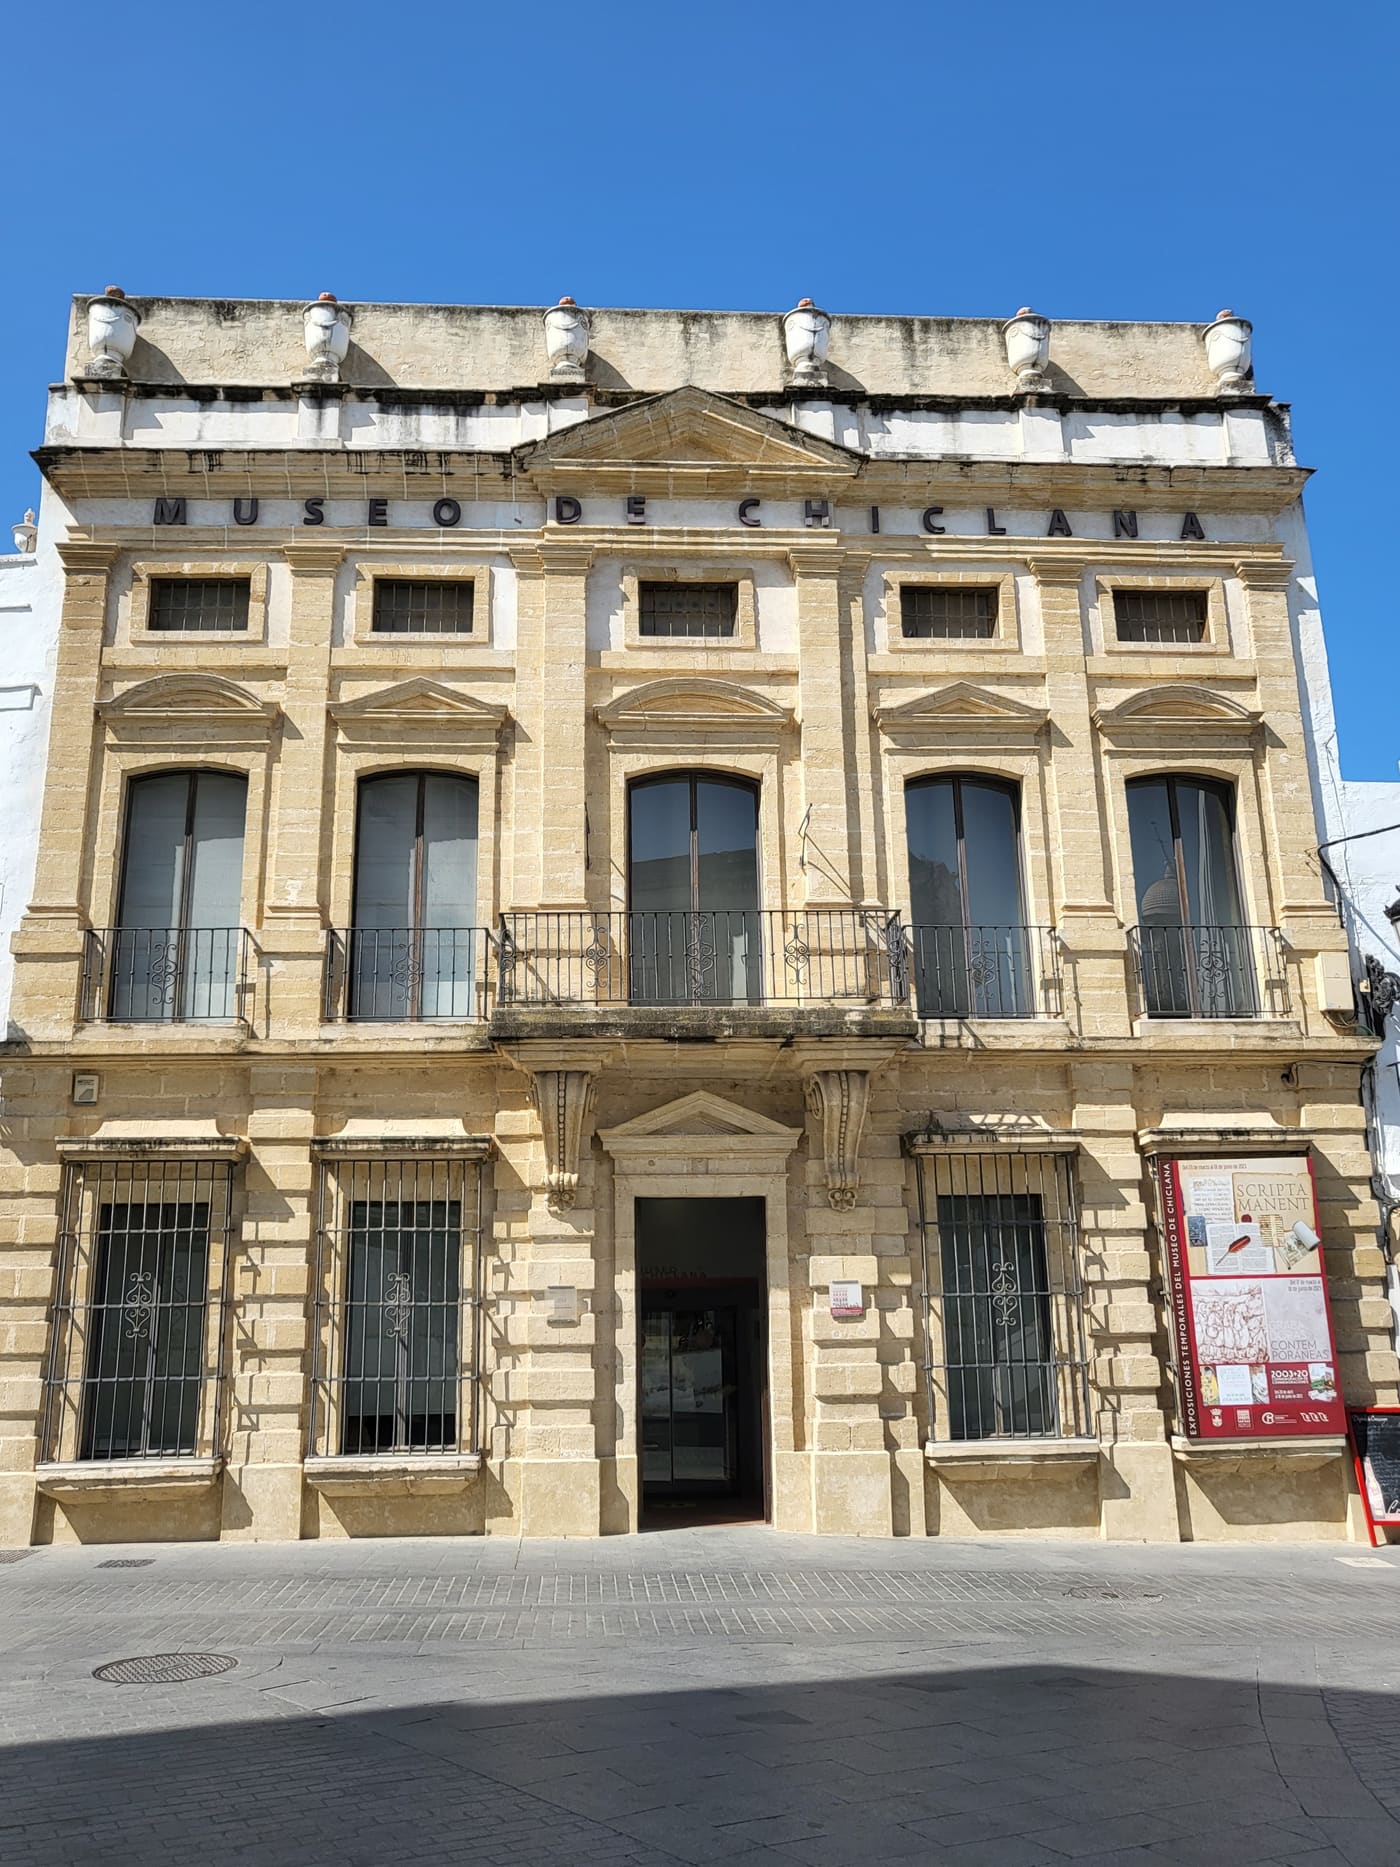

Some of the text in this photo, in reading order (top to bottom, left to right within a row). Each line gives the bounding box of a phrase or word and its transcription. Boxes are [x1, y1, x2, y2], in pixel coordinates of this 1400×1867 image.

[153, 495, 1206, 540] MUSEO DE CHICLANA
[1236, 1183, 1309, 1198] SCRIPTA
[1237, 1197, 1310, 1211] MANENT
[1163, 1163, 1197, 1436] EXPOSICIONES TEMPORALES DEL MUSEO DE CHICLANA
[1270, 1340, 1317, 1350] CONTEM
